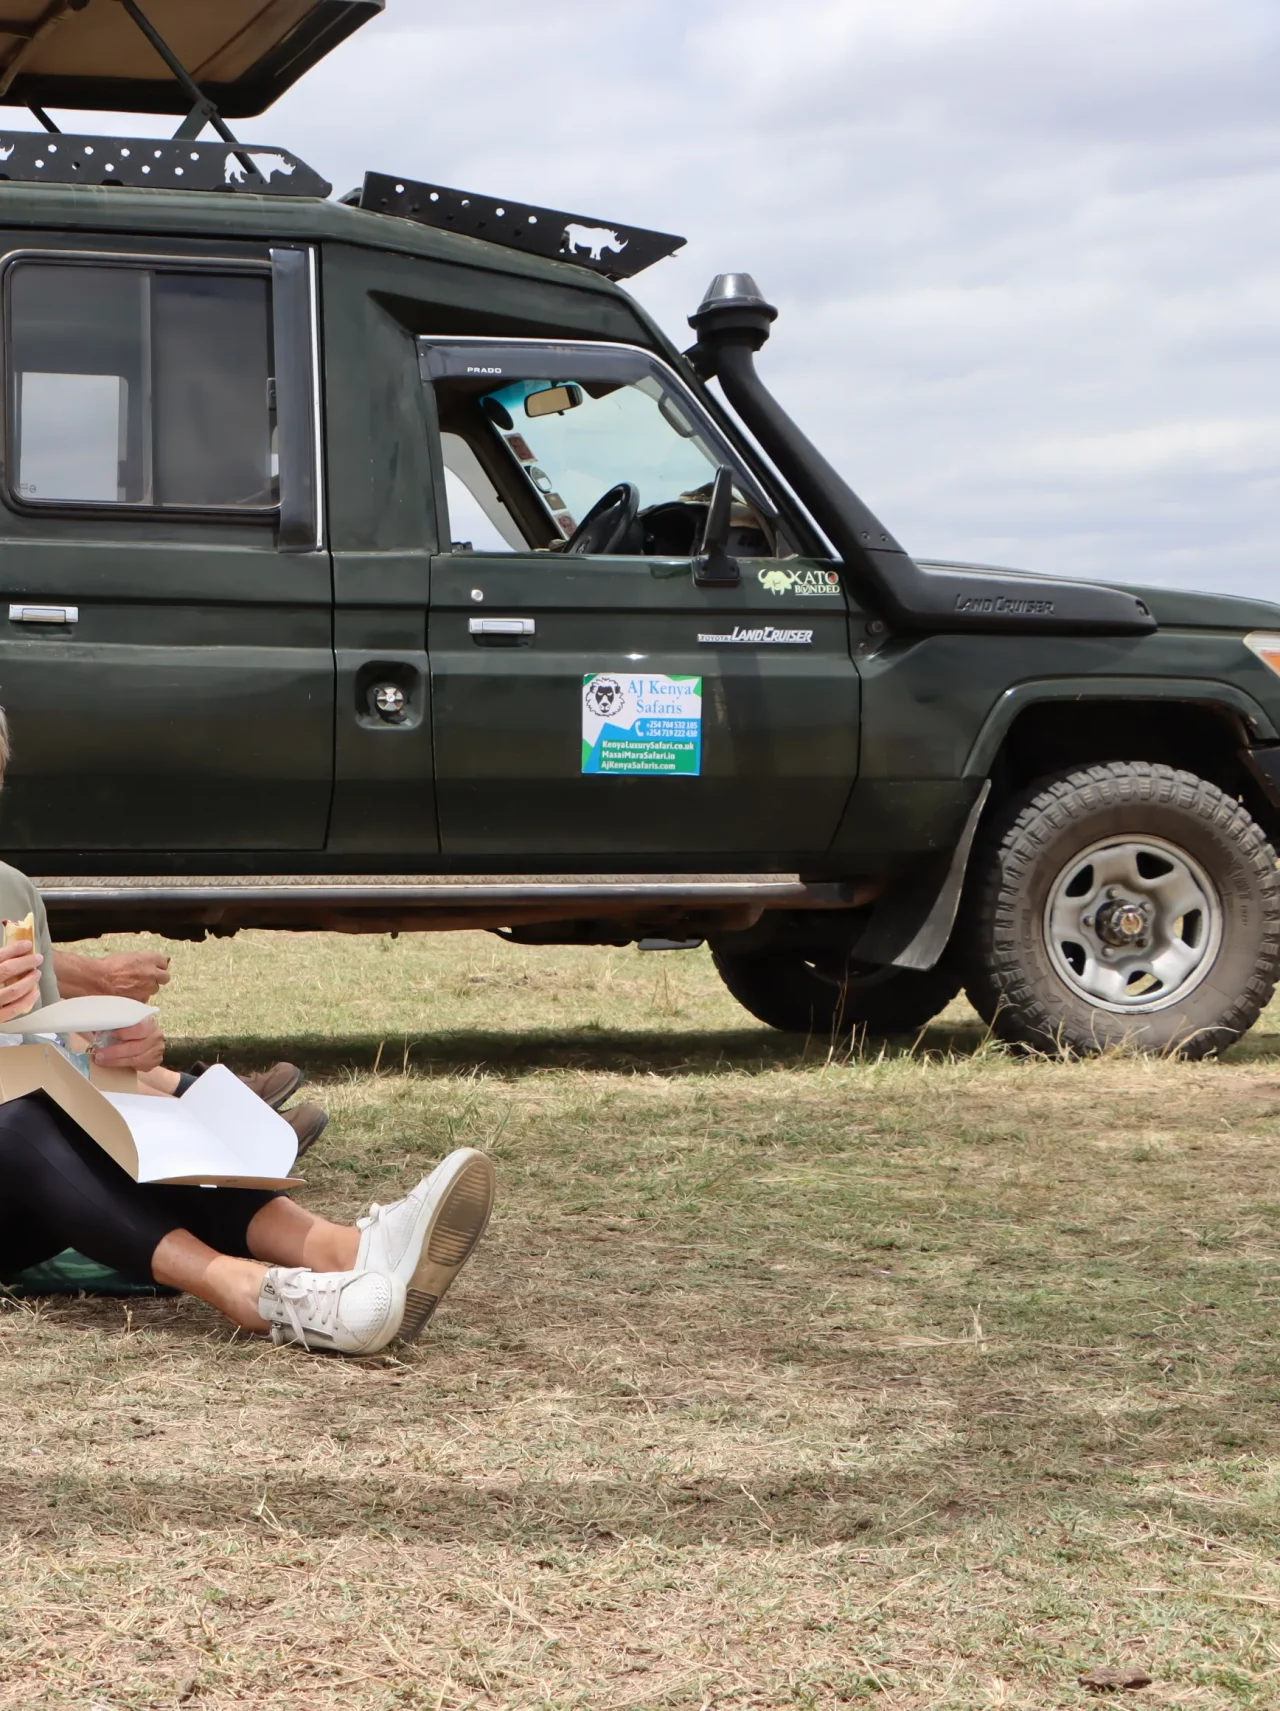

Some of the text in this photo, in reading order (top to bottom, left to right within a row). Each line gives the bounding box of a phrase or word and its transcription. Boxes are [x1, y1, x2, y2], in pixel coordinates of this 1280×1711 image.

[996, 596, 1055, 615] CRUISER
[628, 680, 692, 699] AJ Kenya
[636, 699, 682, 714] Safaris
